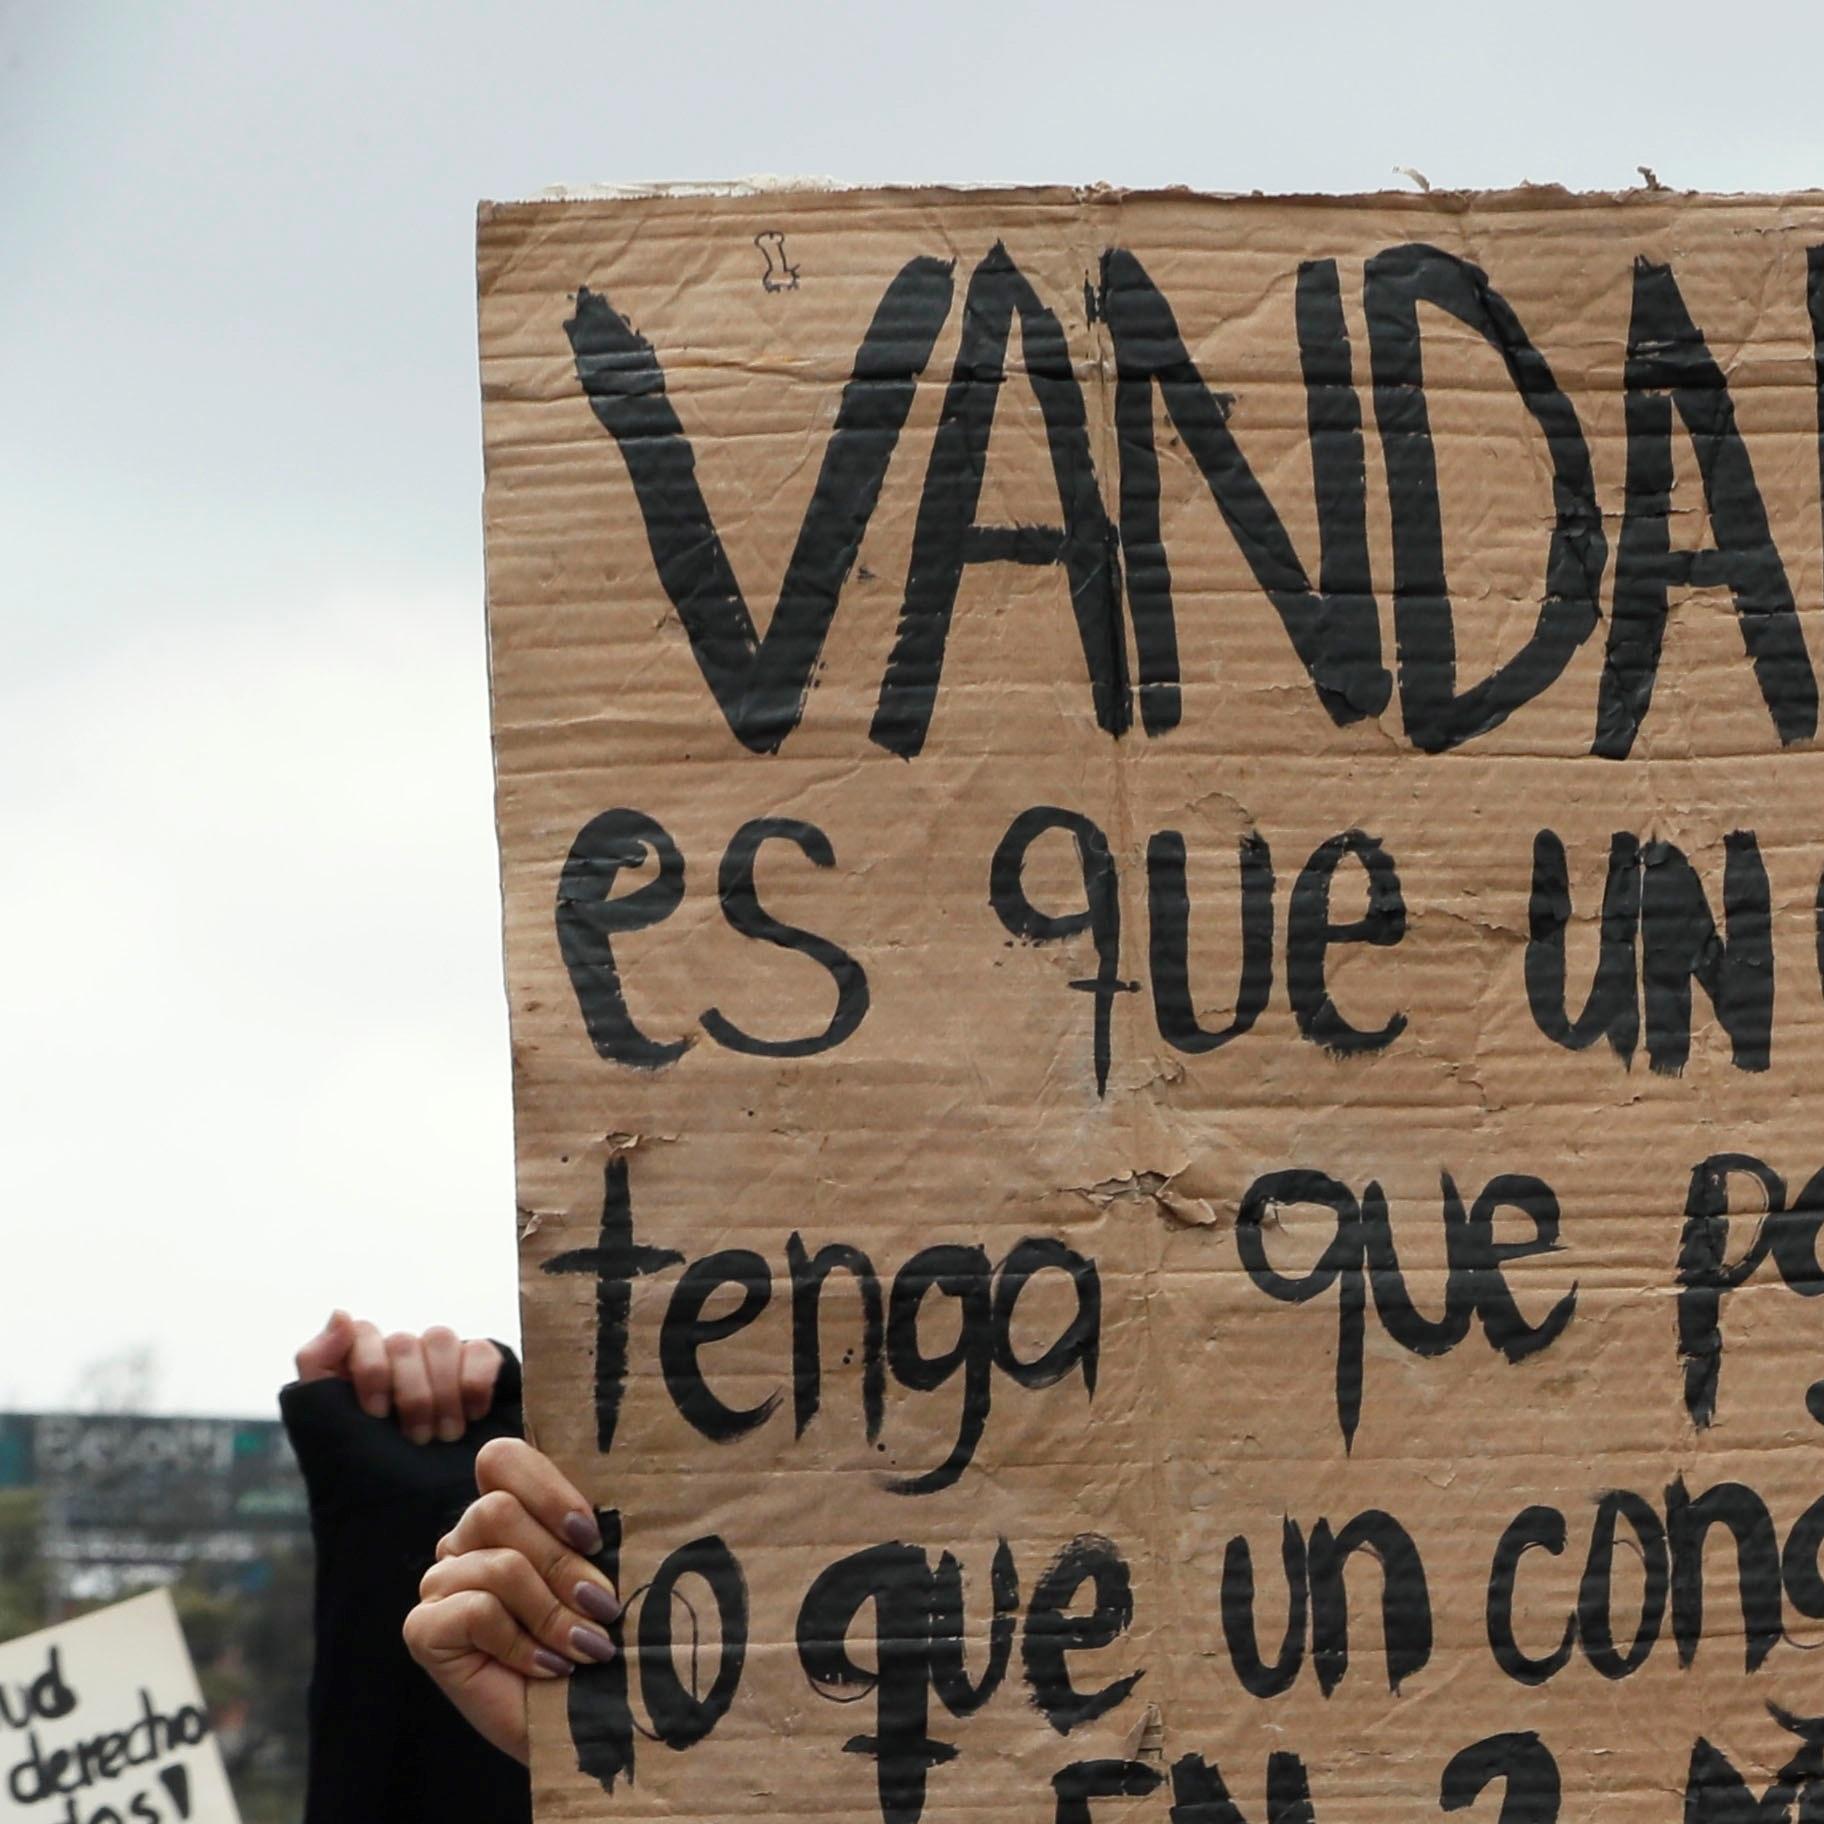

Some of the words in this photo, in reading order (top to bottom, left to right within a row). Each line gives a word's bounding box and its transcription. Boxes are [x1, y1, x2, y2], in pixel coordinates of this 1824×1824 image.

[556, 808, 869, 1069] es
[539, 1156, 1101, 1495] tenga
[1236, 1168, 1578, 1455] que
[0, 1642, 77, 1728] ud
[1220, 1508, 1431, 1698] un
[9, 1688, 207, 1803] derecho
